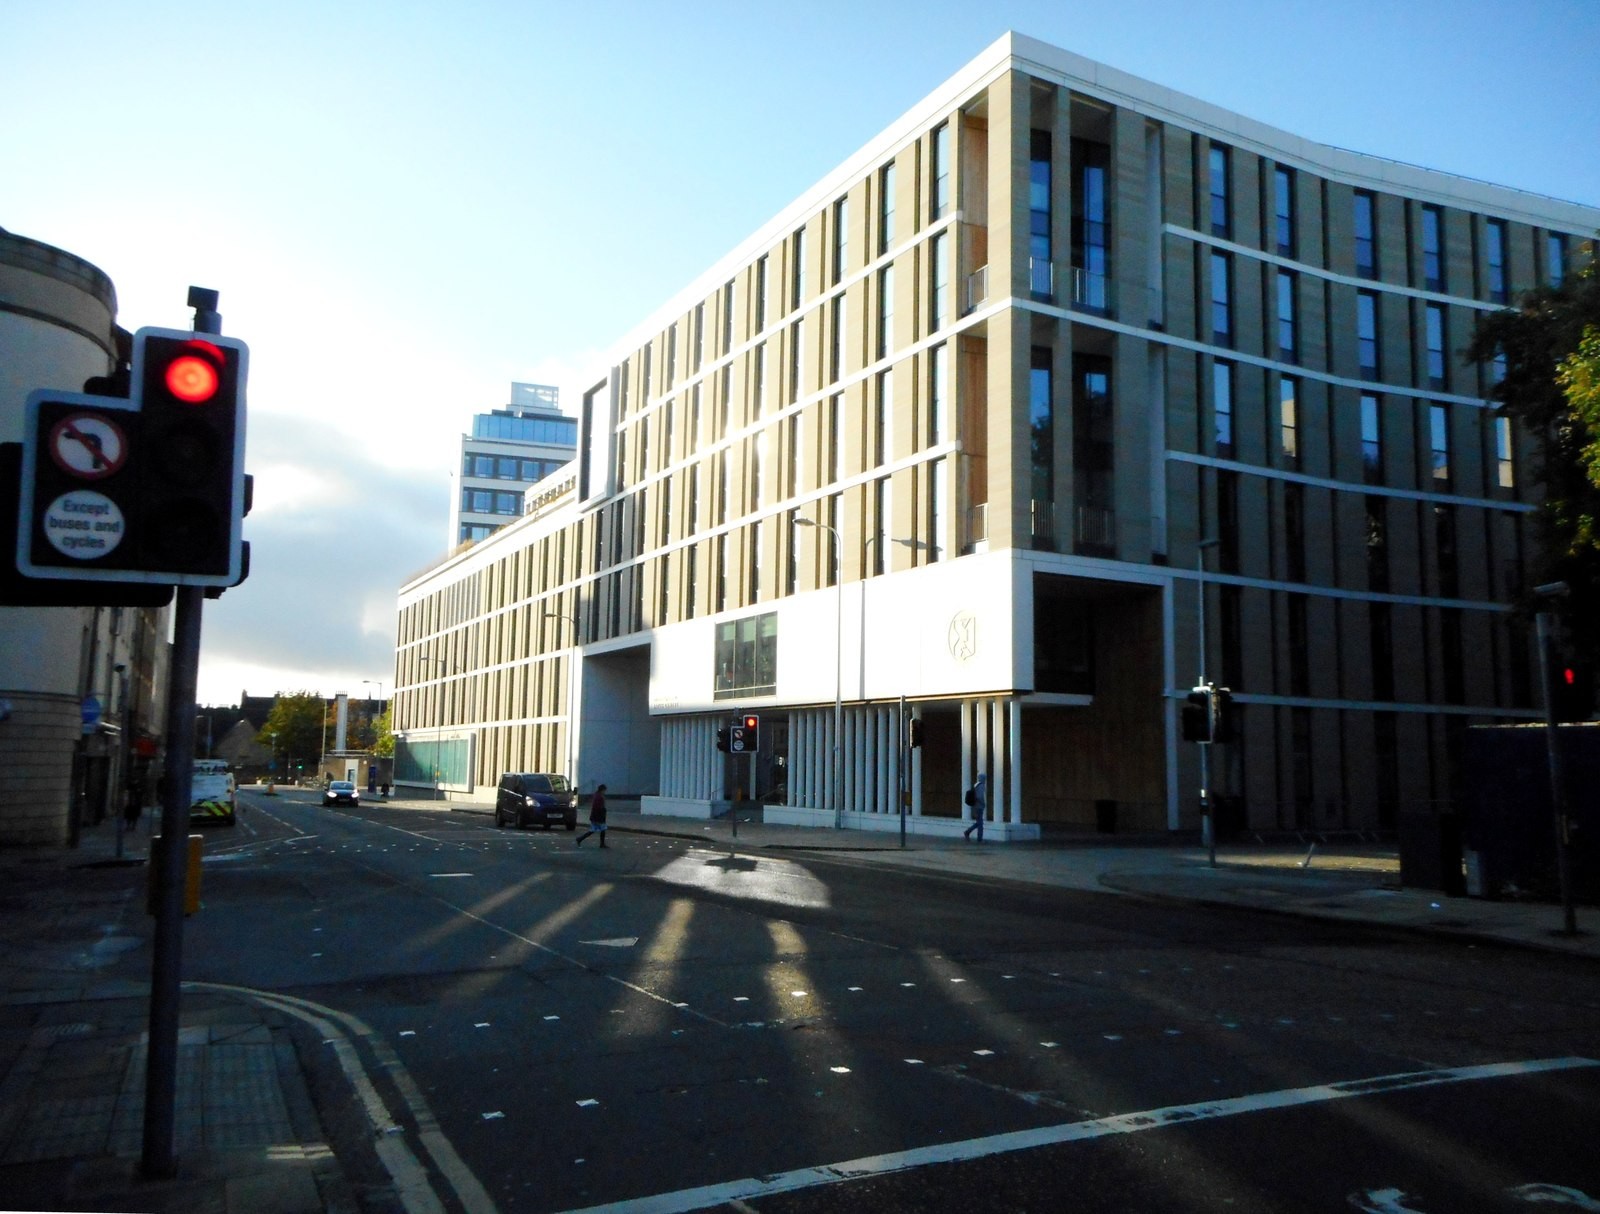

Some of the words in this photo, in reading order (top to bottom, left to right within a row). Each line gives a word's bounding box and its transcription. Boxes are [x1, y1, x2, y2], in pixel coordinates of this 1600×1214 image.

[62, 499, 109, 517] Except
[49, 515, 90, 530] buses
[95, 520, 121, 533] and
[62, 535, 105, 549] cycles
